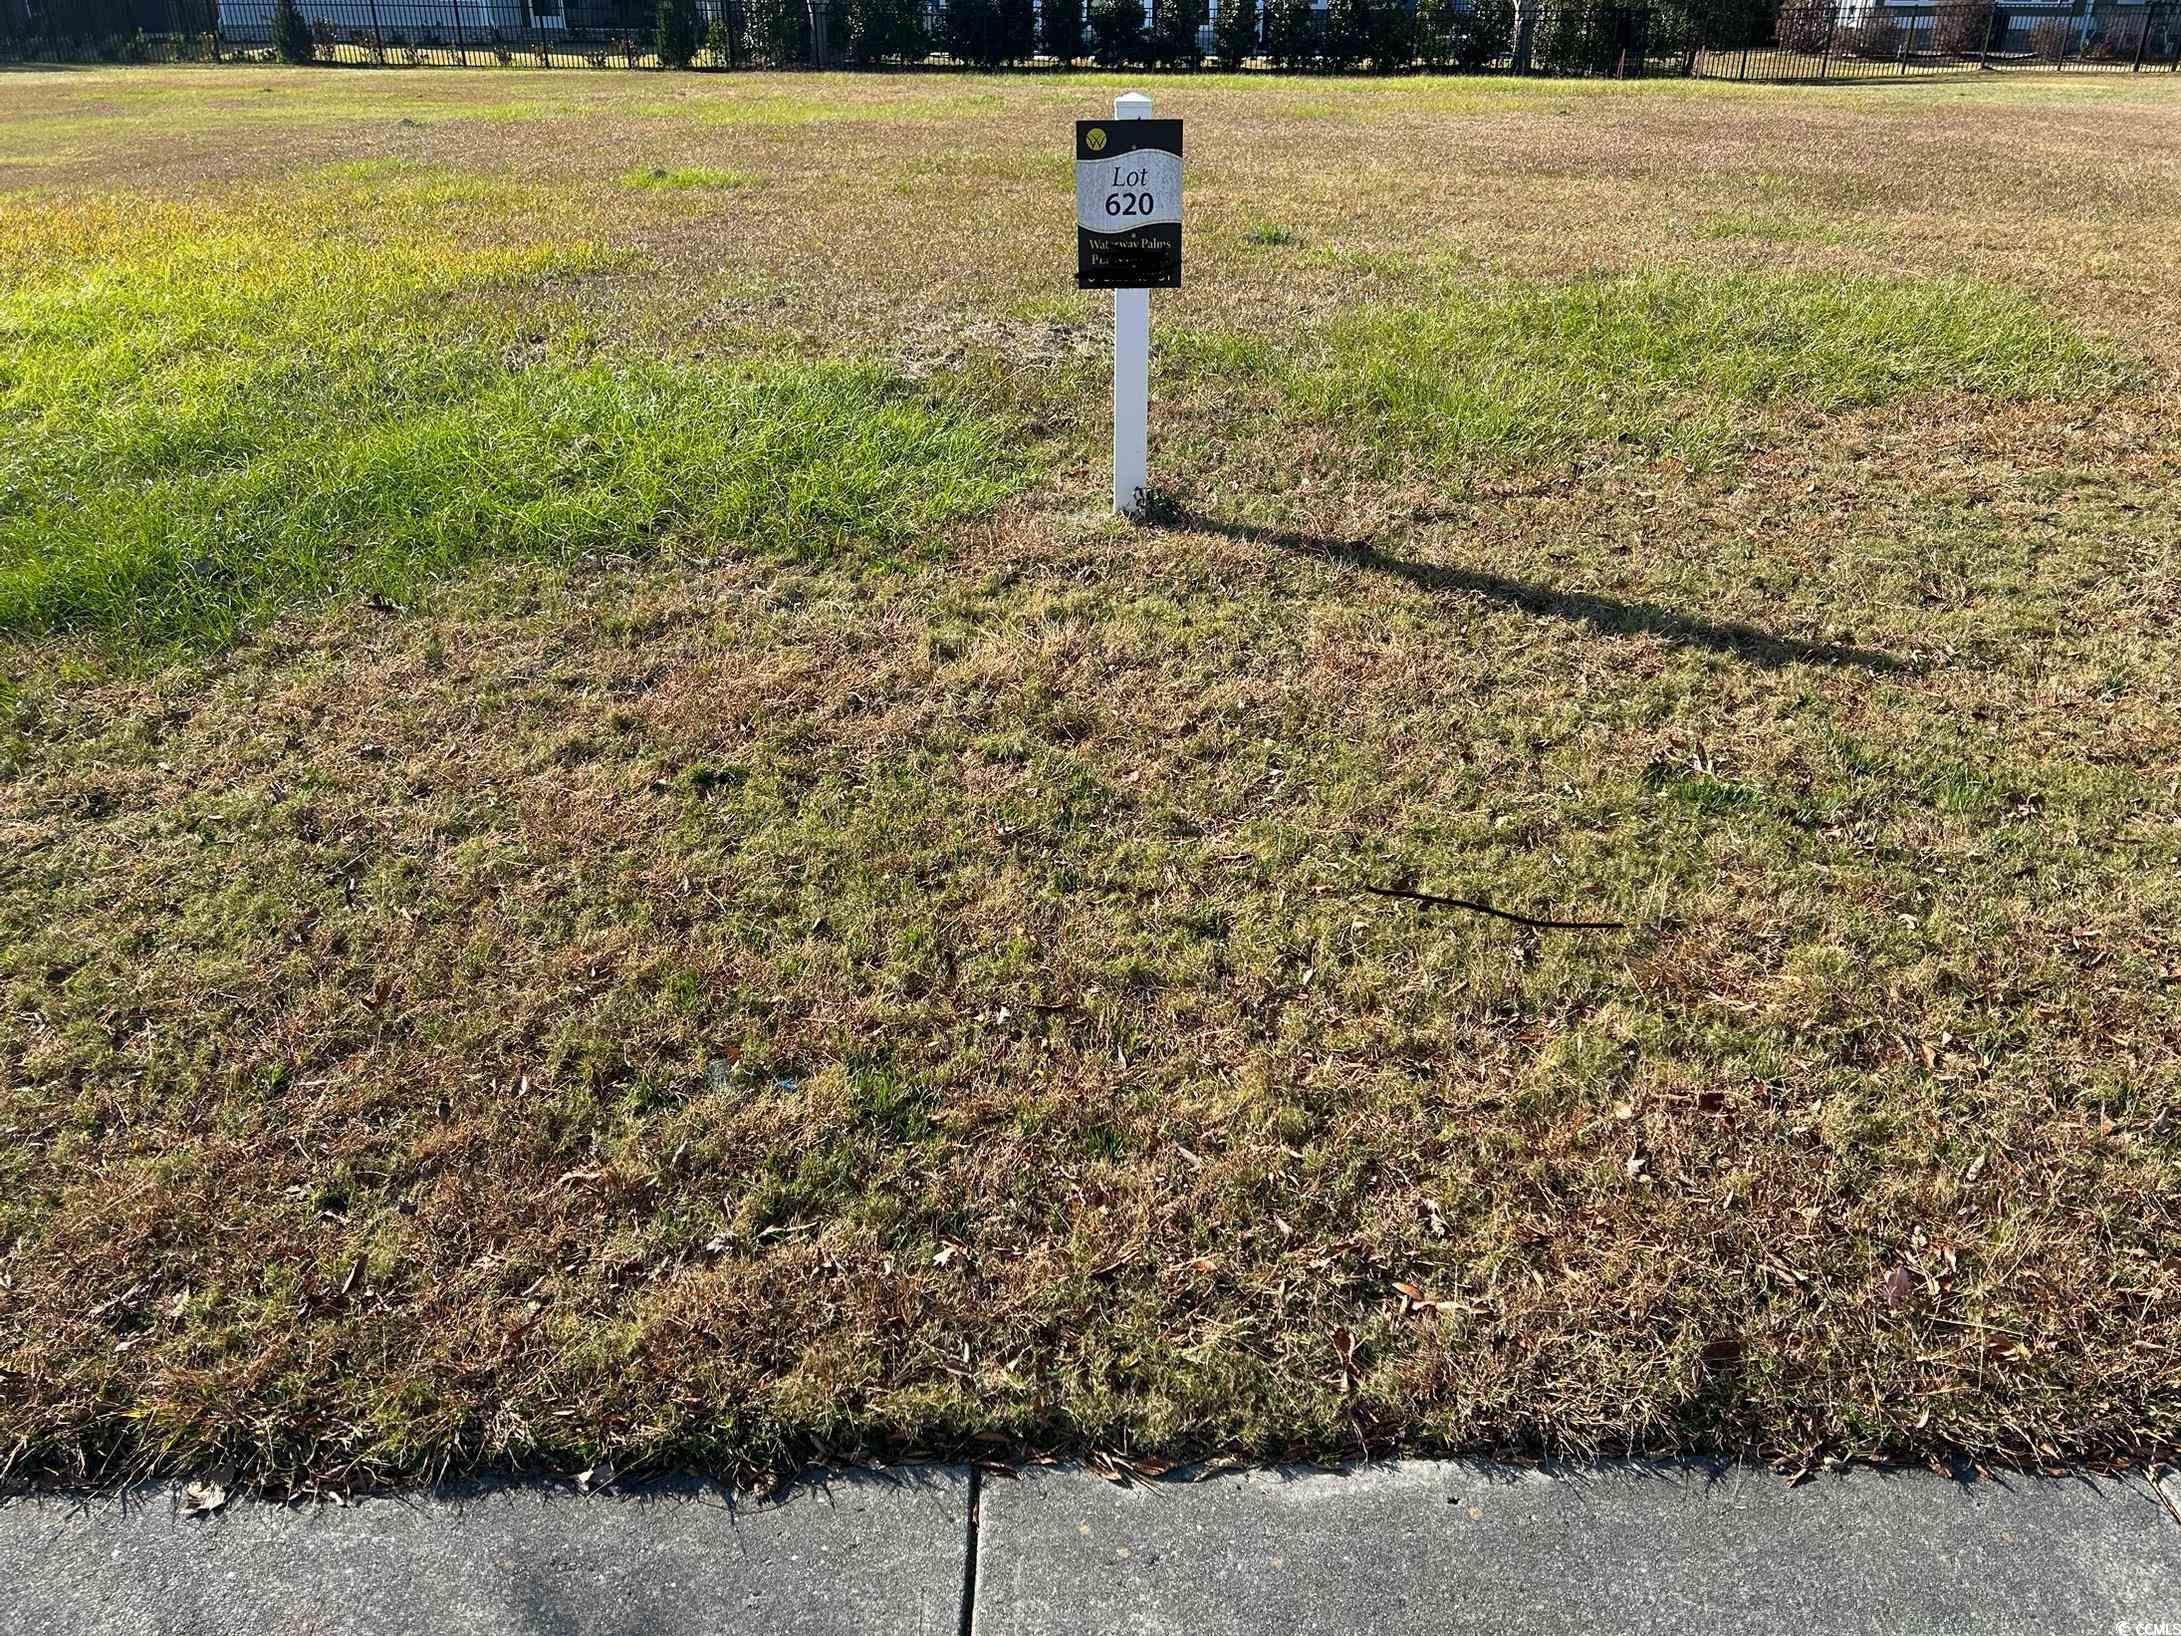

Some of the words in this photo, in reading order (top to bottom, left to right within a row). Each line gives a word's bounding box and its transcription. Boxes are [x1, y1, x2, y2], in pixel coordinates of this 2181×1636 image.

[1112, 167, 1148, 187] Lot
[1105, 193, 1153, 216] 620
[1089, 239, 1138, 250] Watway
[1141, 237, 1171, 249] Palms
